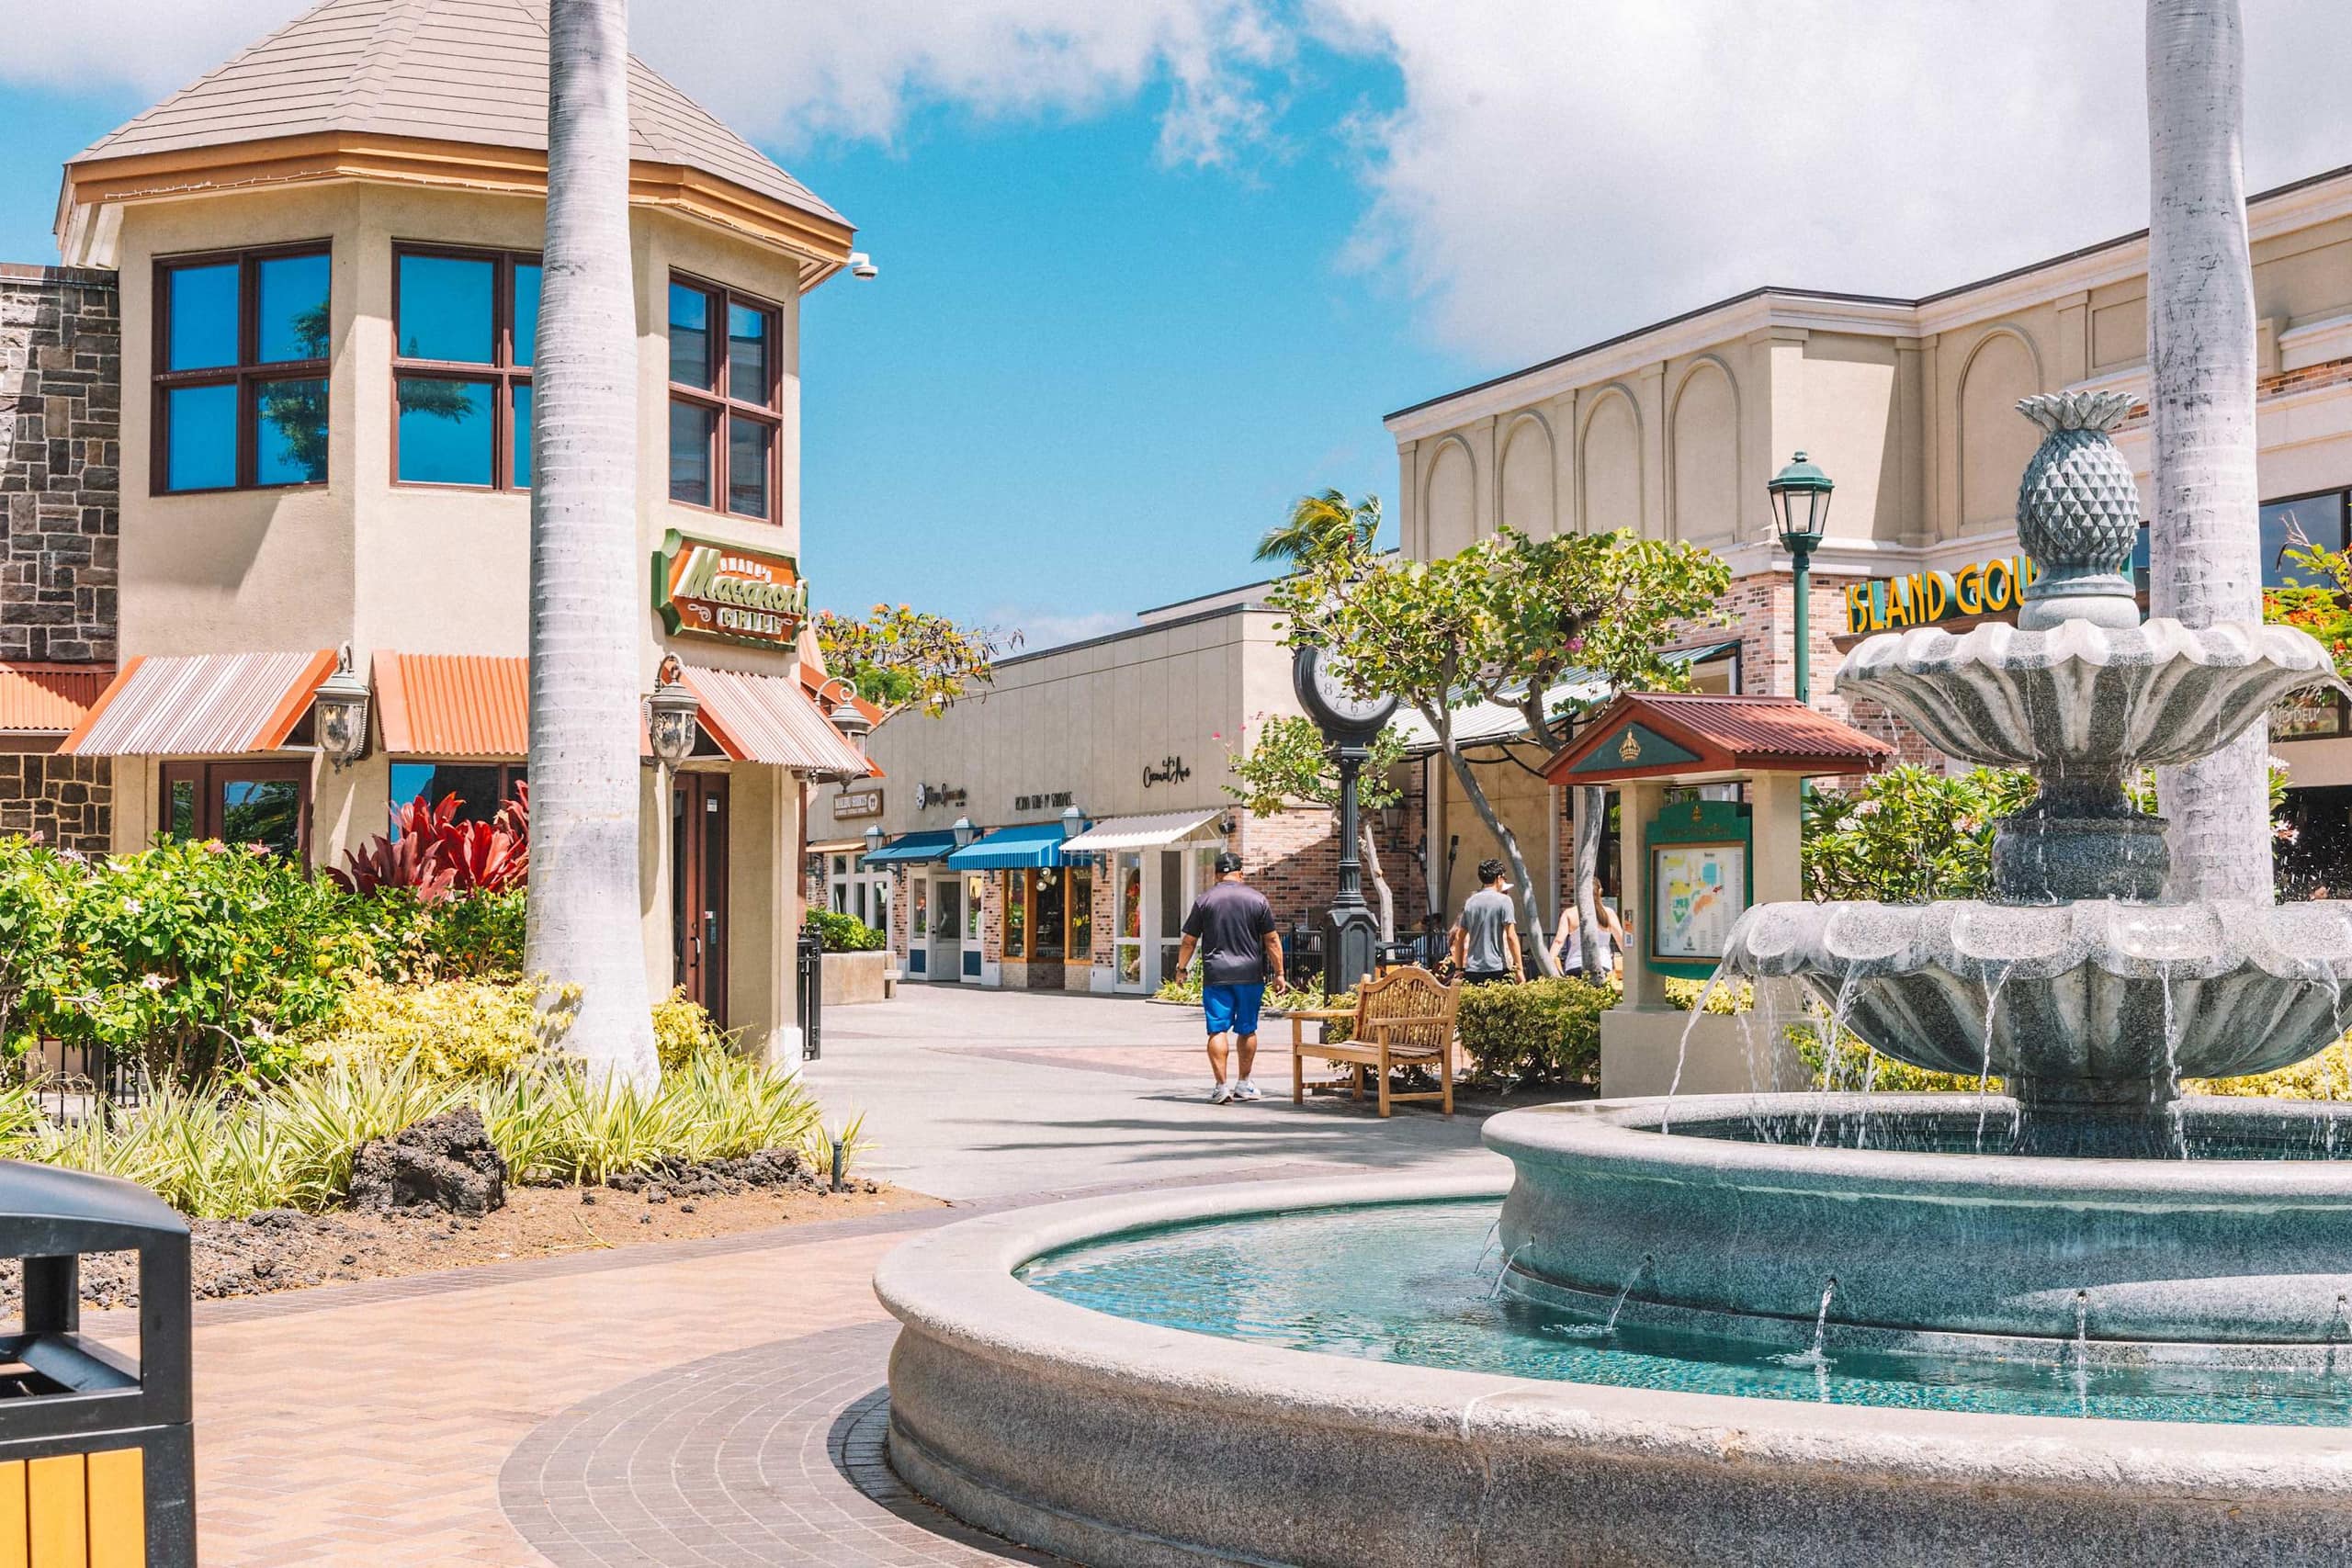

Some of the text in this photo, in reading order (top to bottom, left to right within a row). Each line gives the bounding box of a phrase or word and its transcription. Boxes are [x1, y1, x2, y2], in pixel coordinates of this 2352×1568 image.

[673, 547, 808, 615] Macaroni
[717, 557, 773, 583] OMANO'S
[1845, 555, 2040, 634] ISLAND GOU
[717, 607, 782, 634] GRILL
[1324, 682, 1332, 695] 8
[1351, 702, 1358, 714] 6
